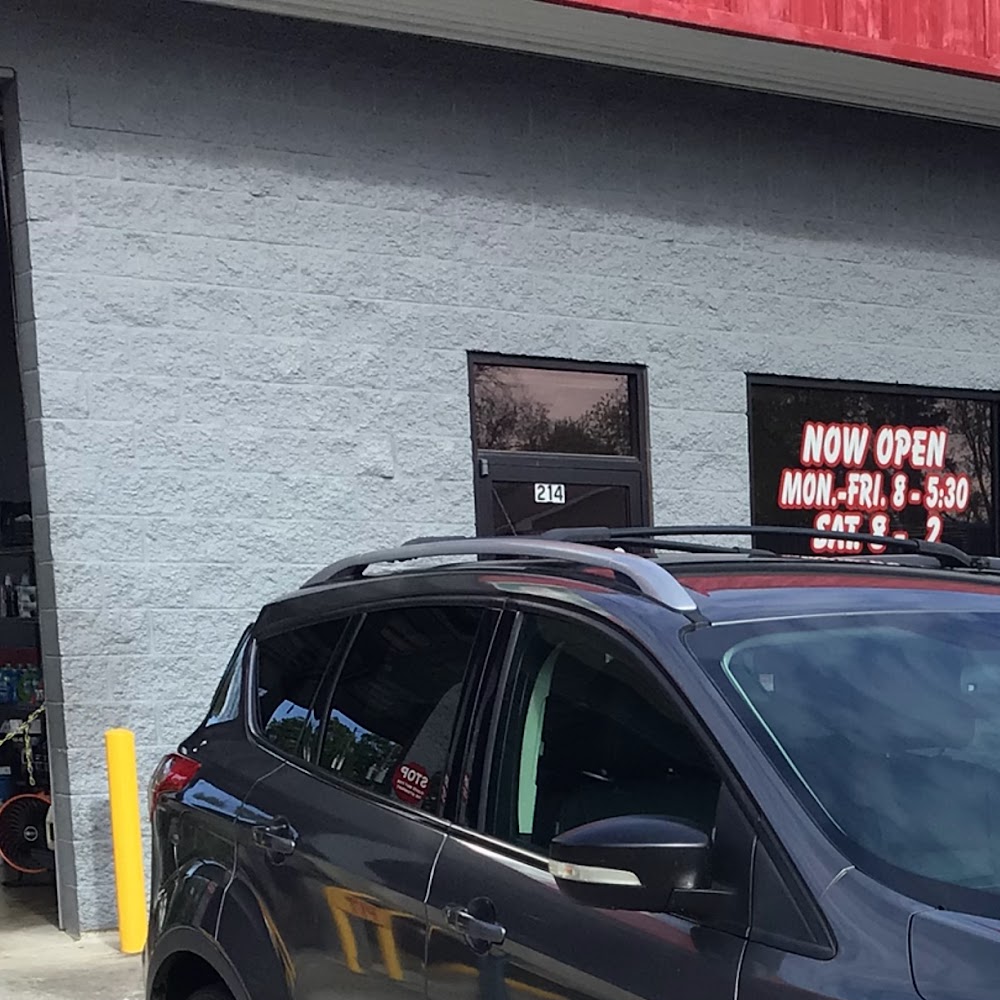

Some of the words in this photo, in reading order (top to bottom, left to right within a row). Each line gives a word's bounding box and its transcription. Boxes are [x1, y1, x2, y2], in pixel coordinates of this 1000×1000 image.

[801, 423, 870, 465] NOW
[874, 426, 948, 468] OPEN
[537, 485, 563, 501] 214
[892, 473, 909, 509] 8
[925, 475, 969, 510] 5:30
[867, 513, 888, 551] 8
[925, 515, 943, 543] 2
